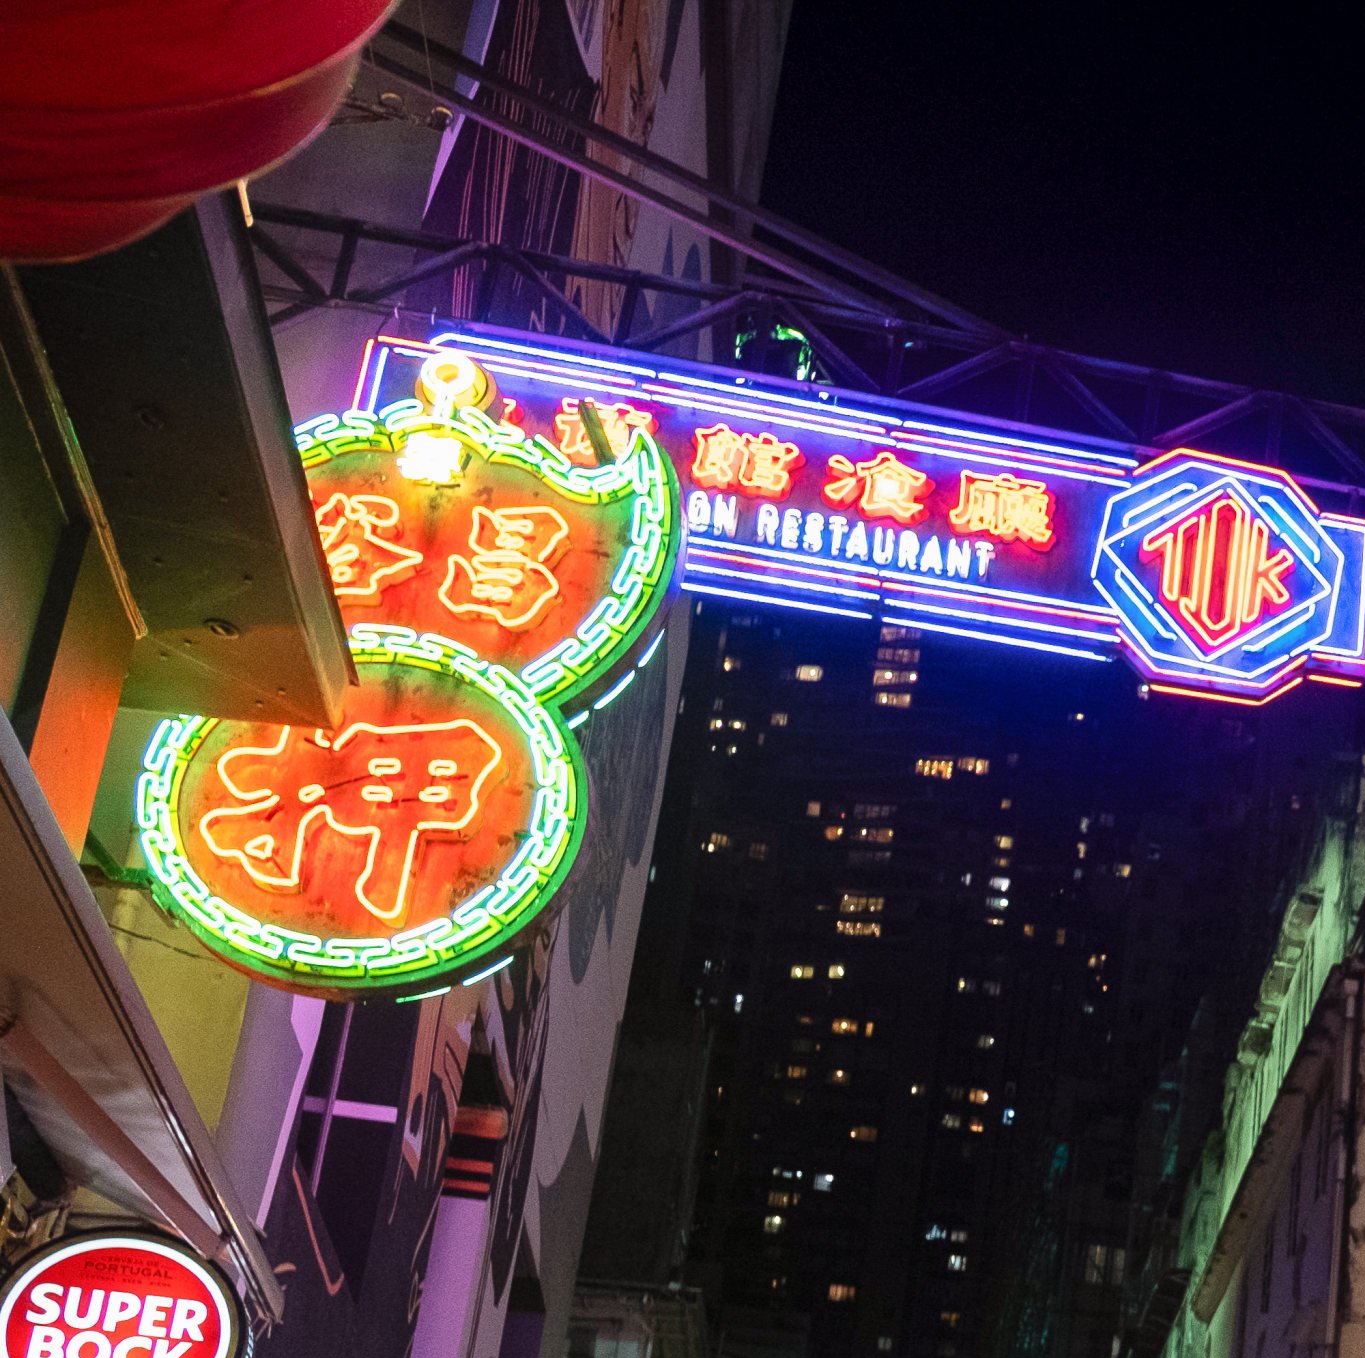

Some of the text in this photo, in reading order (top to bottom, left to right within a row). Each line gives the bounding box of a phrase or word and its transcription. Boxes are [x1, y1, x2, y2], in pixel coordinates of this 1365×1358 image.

[754, 512, 997, 580] RESTAURANT
[84, 1260, 173, 1280] PORTUGAL
[25, 1282, 208, 1342] SUPER
